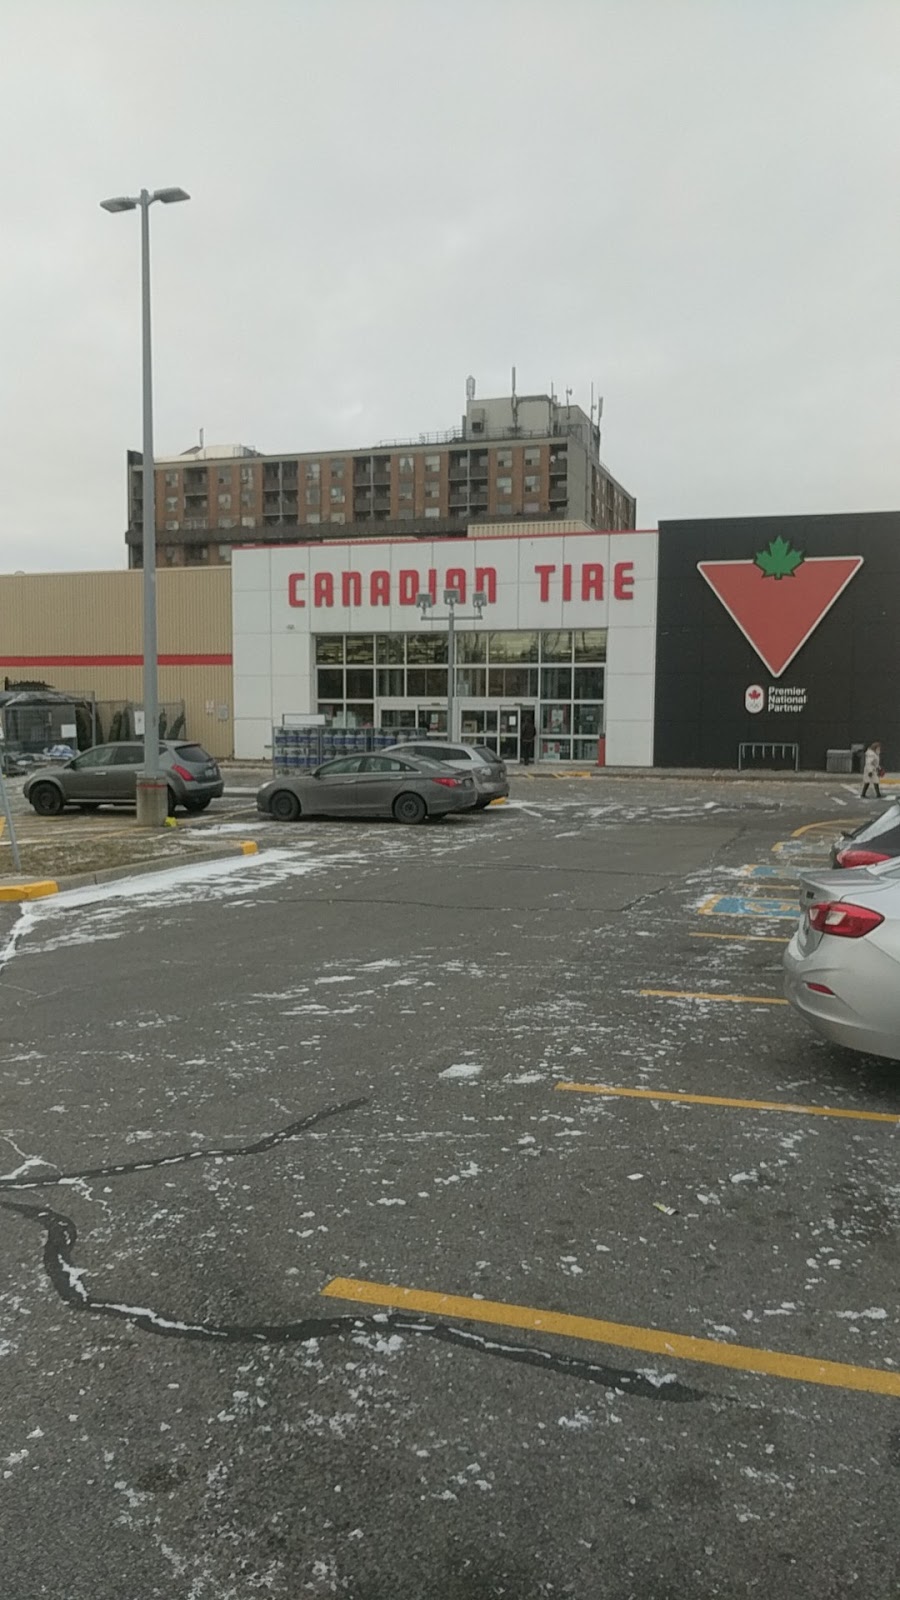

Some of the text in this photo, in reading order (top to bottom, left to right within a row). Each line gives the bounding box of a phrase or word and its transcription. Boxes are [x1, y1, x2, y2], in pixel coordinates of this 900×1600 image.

[288, 562, 634, 608] CANADIAN TIRE
[768, 686, 806, 695] Premier
[768, 695, 807, 704] National
[768, 703, 804, 712] Partner
